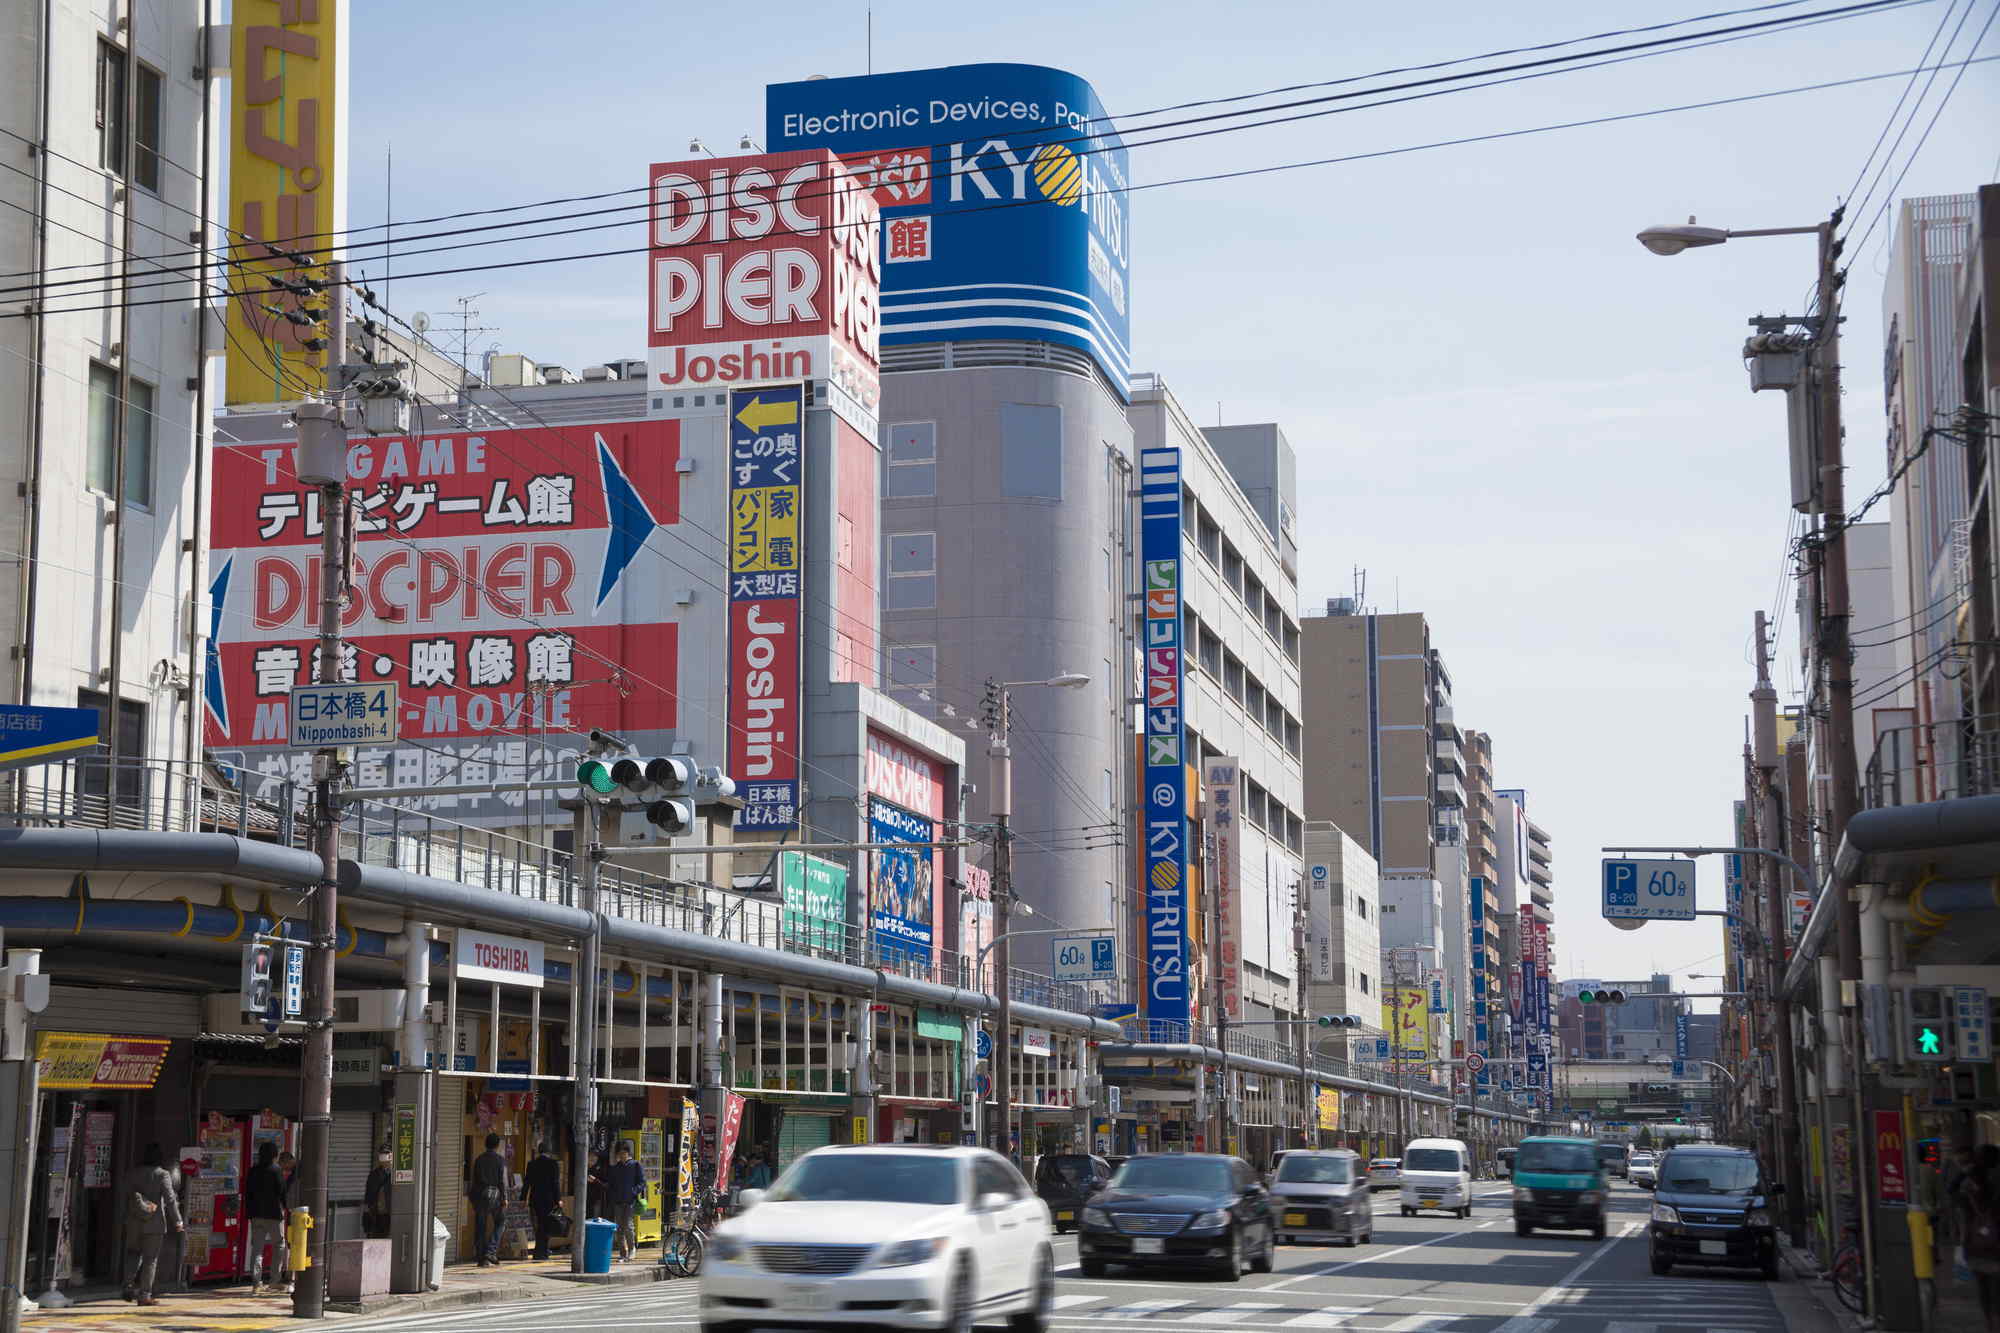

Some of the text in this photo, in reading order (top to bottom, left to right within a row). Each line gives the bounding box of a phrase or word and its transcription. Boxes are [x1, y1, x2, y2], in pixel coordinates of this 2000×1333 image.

[784, 105, 920, 137] Electronic
[929, 96, 1047, 124] Devices,
[655, 161, 821, 248] DISC
[889, 217, 929, 259] 館
[655, 247, 822, 333] PIER
[659, 342, 811, 385] Joshin
[350, 437, 487, 480] GAME
[735, 433, 798, 460] この奥
[735, 459, 797, 487] すぐ
[736, 489, 762, 569] パソコン
[768, 489, 794, 568] 家電
[734, 573, 798, 598] 大型店
[1147, 561, 1178, 765] シリコンハウス
[298, 689, 389, 722] 日本橋4
[746, 604, 785, 777] Joshin
[297, 726, 389, 743] Nipponbashi-4
[748, 785, 792, 803] 日本橋
[1521, 909, 1533, 956] Joshin
[1536, 929, 1547, 973] Joshin
[474, 943, 529, 973] TOSHIBA
